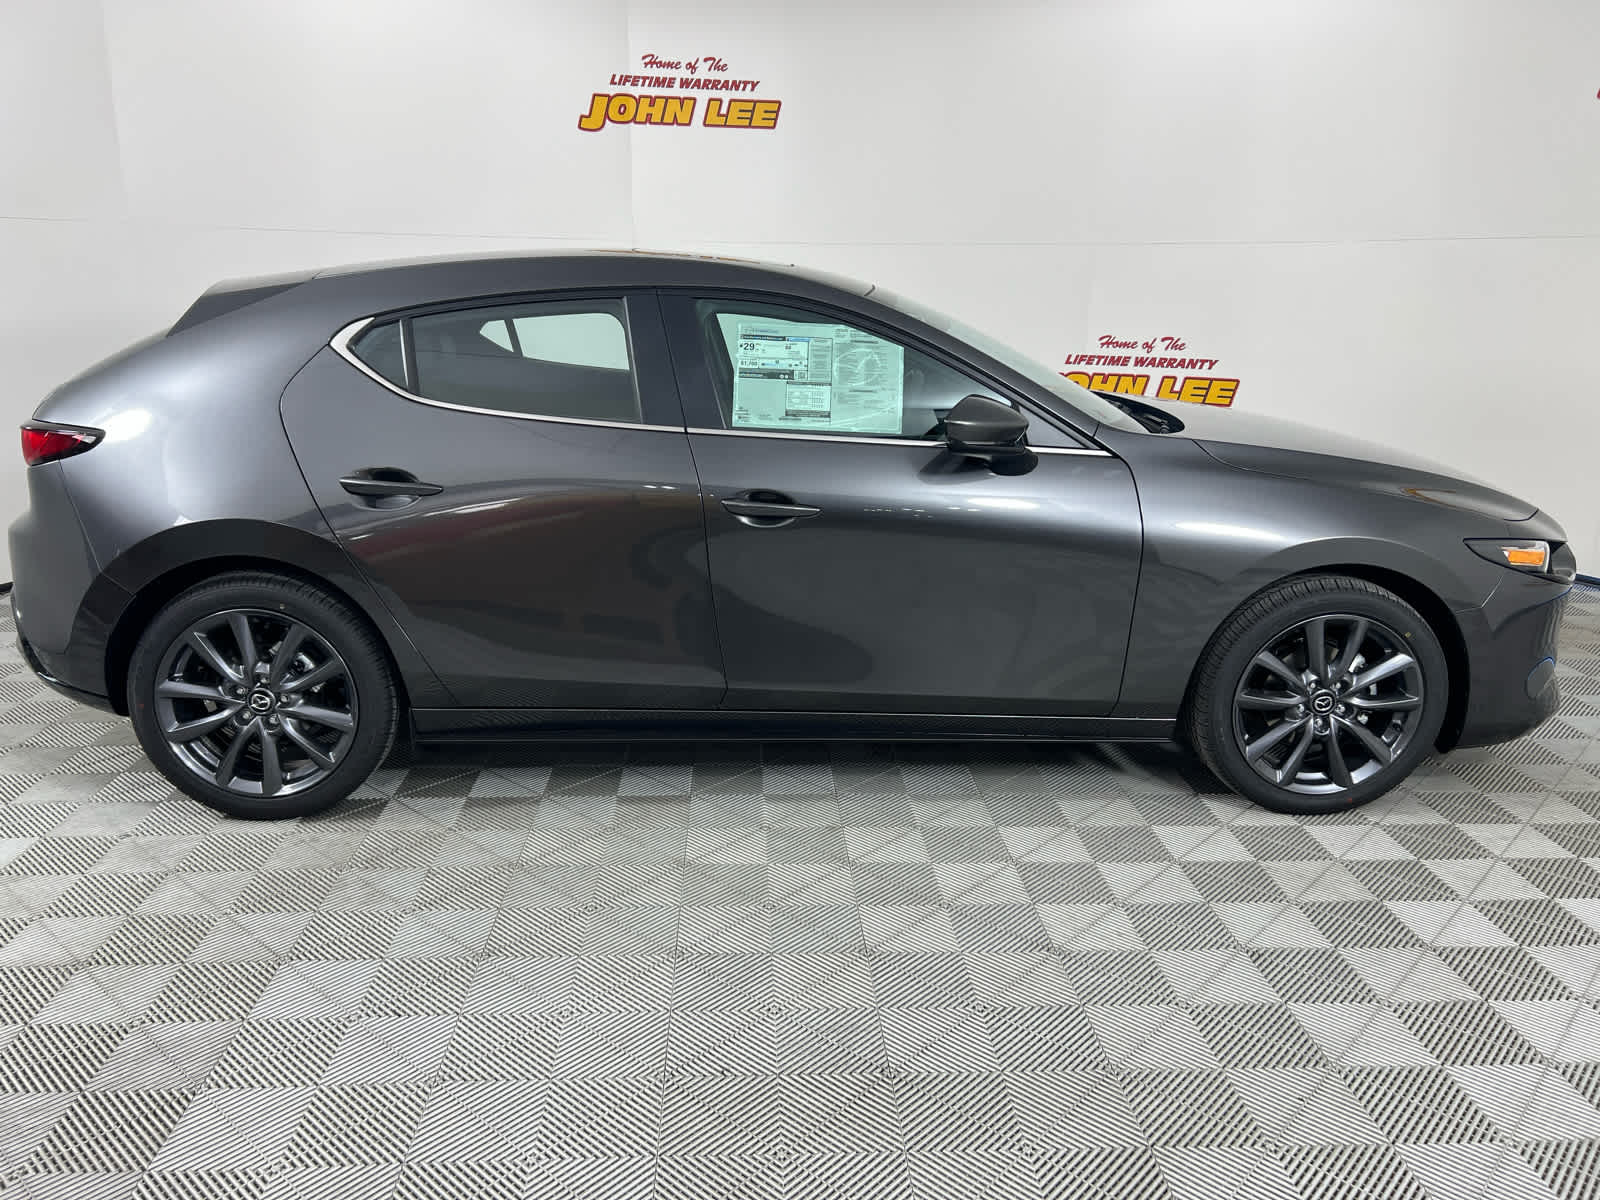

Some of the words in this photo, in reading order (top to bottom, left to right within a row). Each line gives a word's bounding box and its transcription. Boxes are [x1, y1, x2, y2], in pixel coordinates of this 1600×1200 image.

[641, 54, 681, 69] Home
[685, 58, 699, 74] of
[703, 57, 728, 72] The
[609, 74, 676, 89] LIFETIME
[679, 78, 760, 92] WARRANTY
[578, 93, 697, 132] JOHN
[703, 98, 782, 129] LEE
[743, 342, 755, 351] 29
[1098, 335, 1138, 349] Home
[1142, 338, 1157, 353] of
[1161, 337, 1186, 350] The
[1064, 354, 1131, 367] LIFETIME
[1134, 356, 1219, 370] WARRANTY
[1059, 371, 1151, 396] OHN
[1156, 376, 1240, 407] LEE
